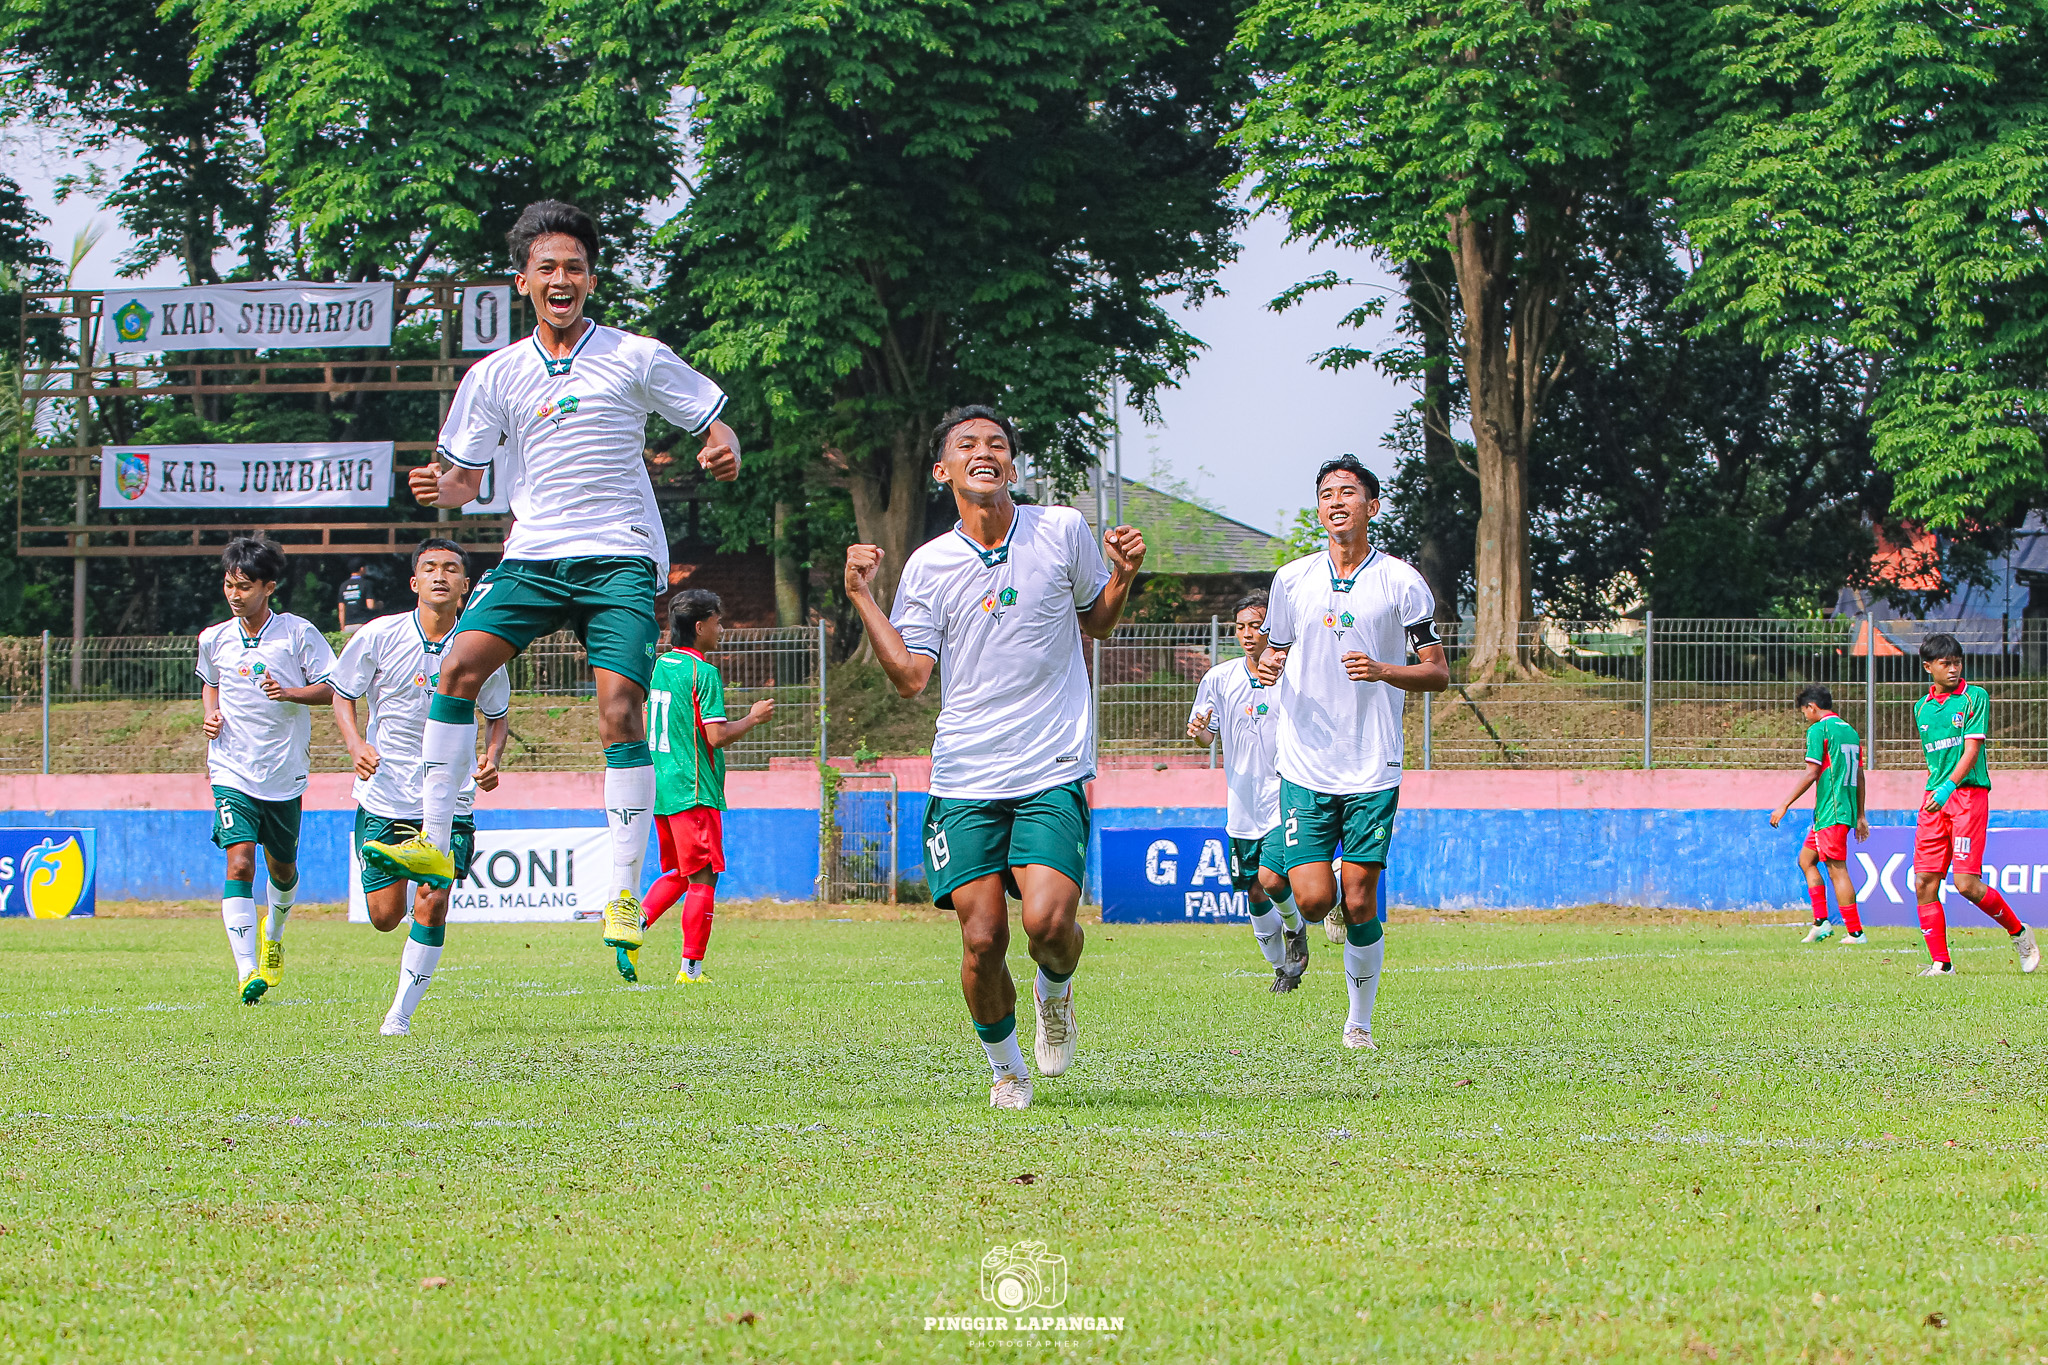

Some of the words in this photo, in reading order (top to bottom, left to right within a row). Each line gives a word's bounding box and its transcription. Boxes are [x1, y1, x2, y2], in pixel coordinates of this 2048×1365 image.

[161, 303, 224, 335] KAB.
[237, 299, 373, 333] SIDOARJO
[475, 291, 497, 343] 0
[161, 461, 225, 492] KAB.
[240, 459, 373, 492] JOMBANG
[468, 583, 494, 610] 7
[220, 805, 235, 830] 6
[1285, 817, 1299, 847] 2
[926, 829, 951, 872] 19
[452, 894, 494, 909] KAB.
[500, 892, 577, 908] MALANG
